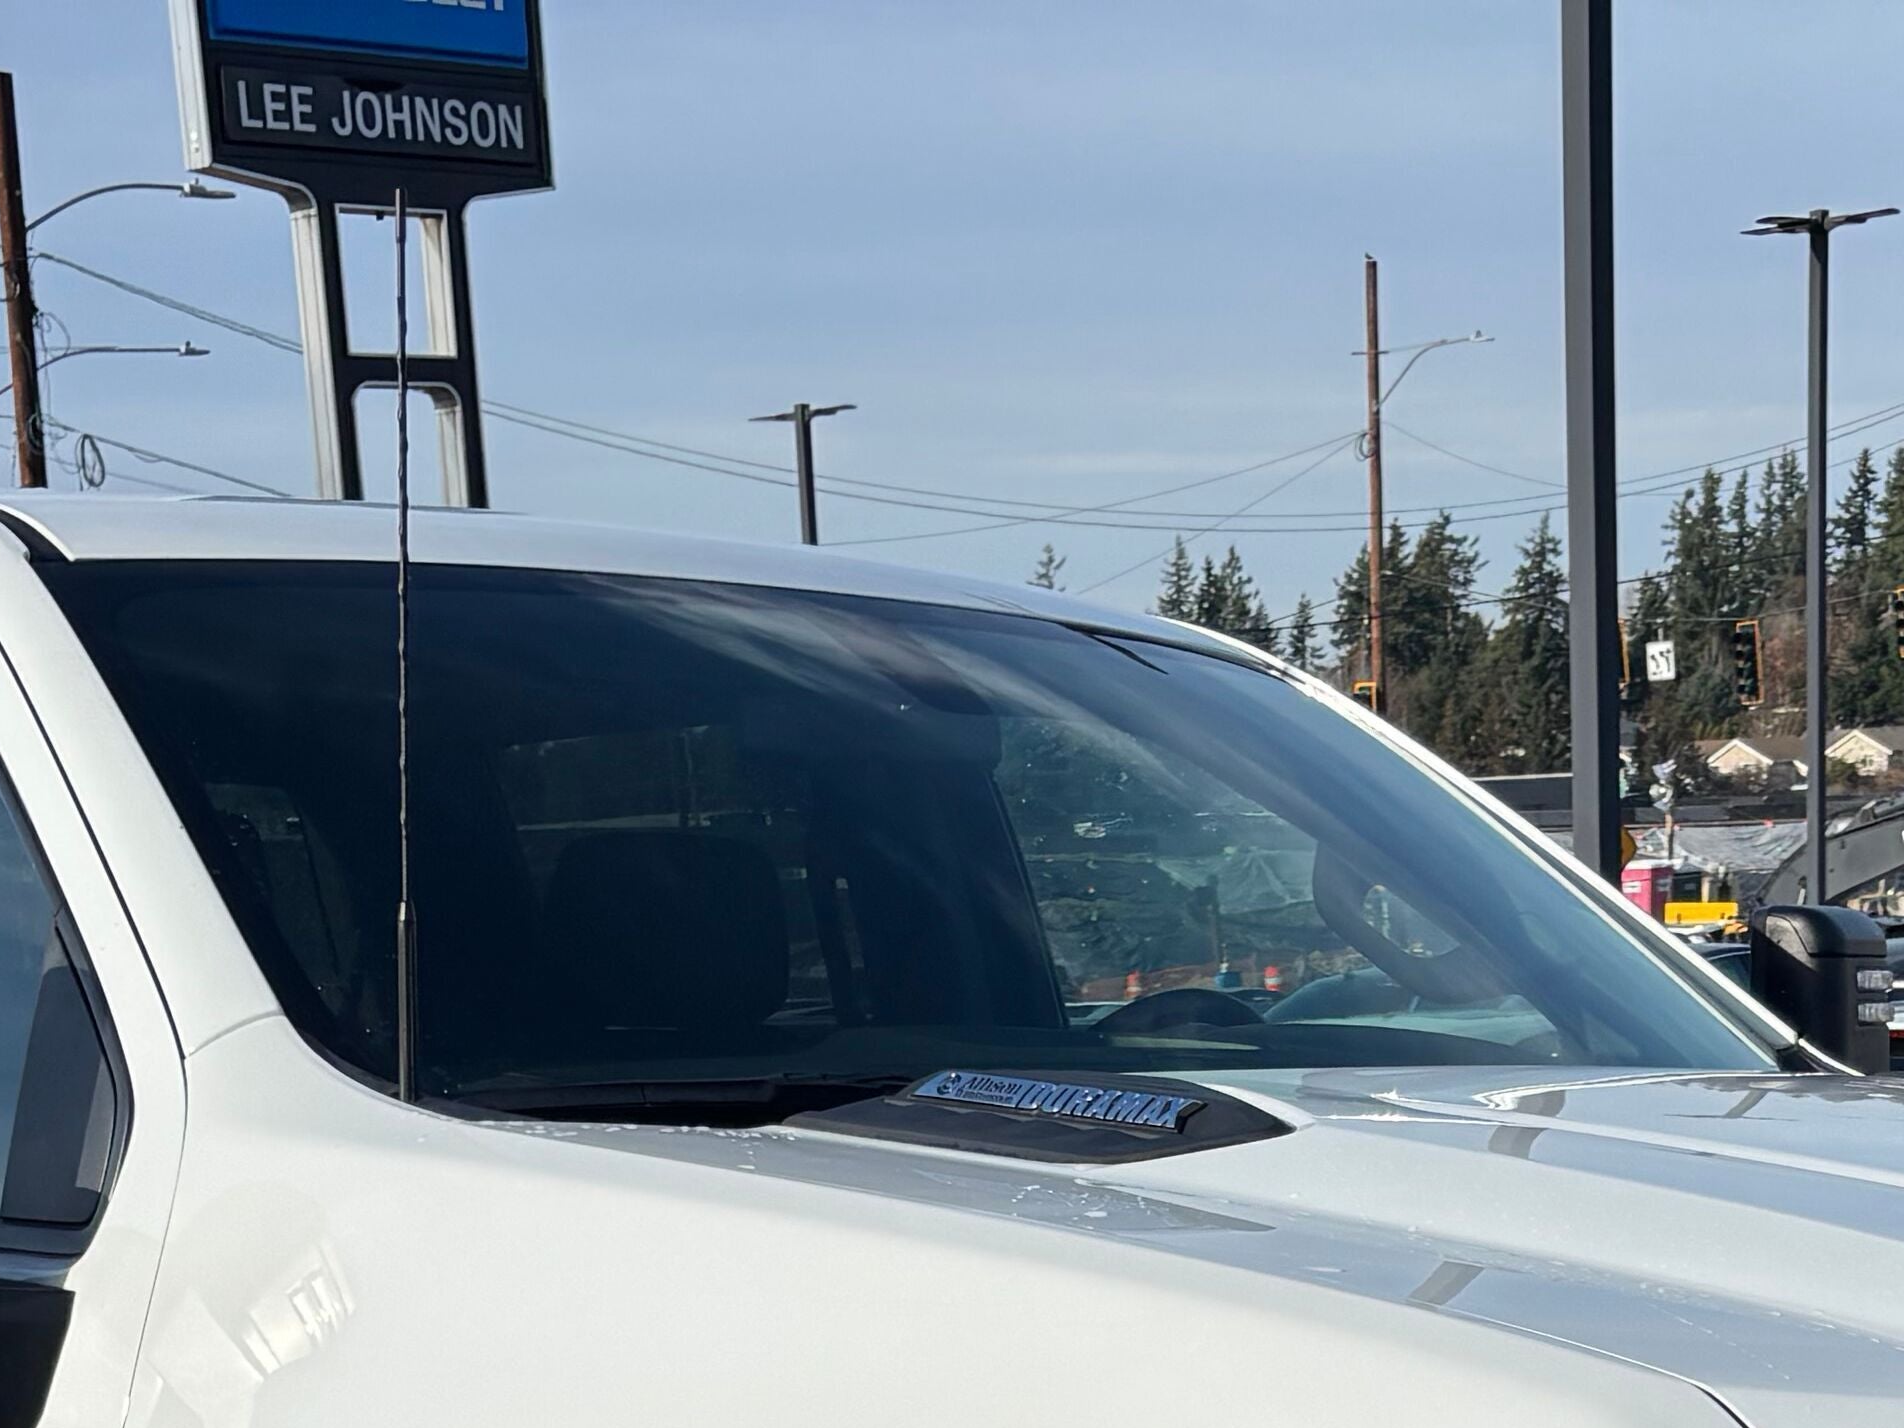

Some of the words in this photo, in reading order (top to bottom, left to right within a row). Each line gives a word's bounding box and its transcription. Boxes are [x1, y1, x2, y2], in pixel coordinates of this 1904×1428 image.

[237, 80, 317, 132] LEE
[332, 89, 525, 150] JOHNSON
[962, 1076, 1023, 1095] Allison
[1017, 1082, 1184, 1129] DURAMAX
